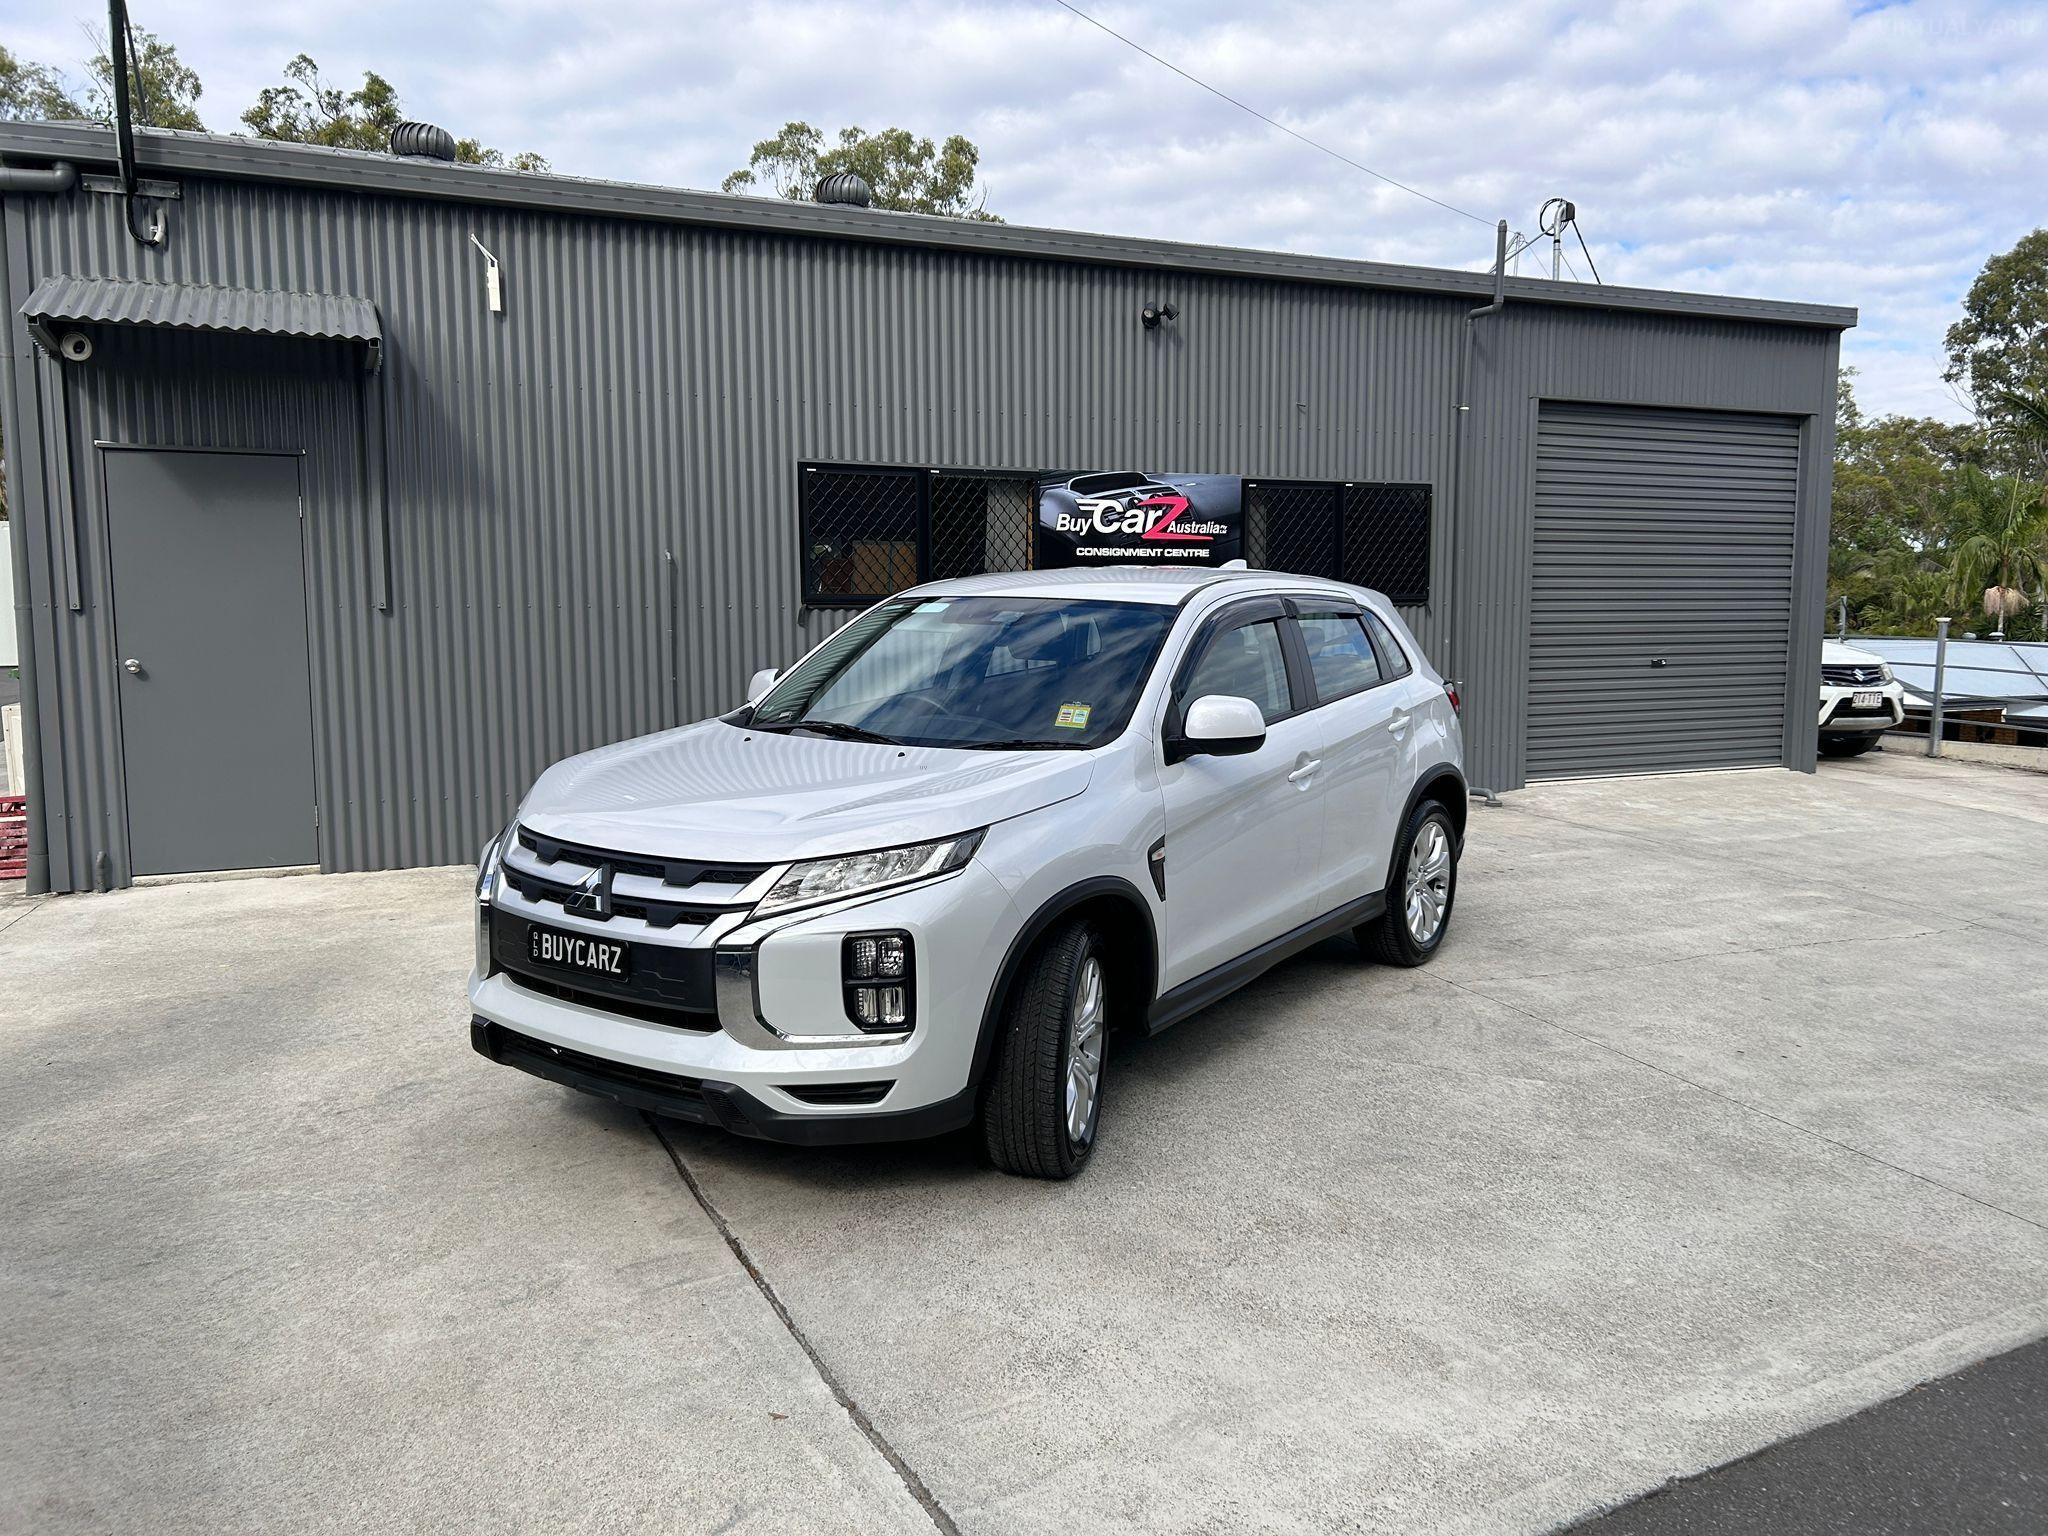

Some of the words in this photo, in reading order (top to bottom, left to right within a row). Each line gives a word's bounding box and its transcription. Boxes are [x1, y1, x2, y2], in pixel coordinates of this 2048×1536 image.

[1167, 521, 1219, 533] Australia
[1076, 547, 1163, 557] CONSIGNMENT
[1164, 548, 1210, 557] CENTRE
[542, 933, 622, 973] BUYCARZ
